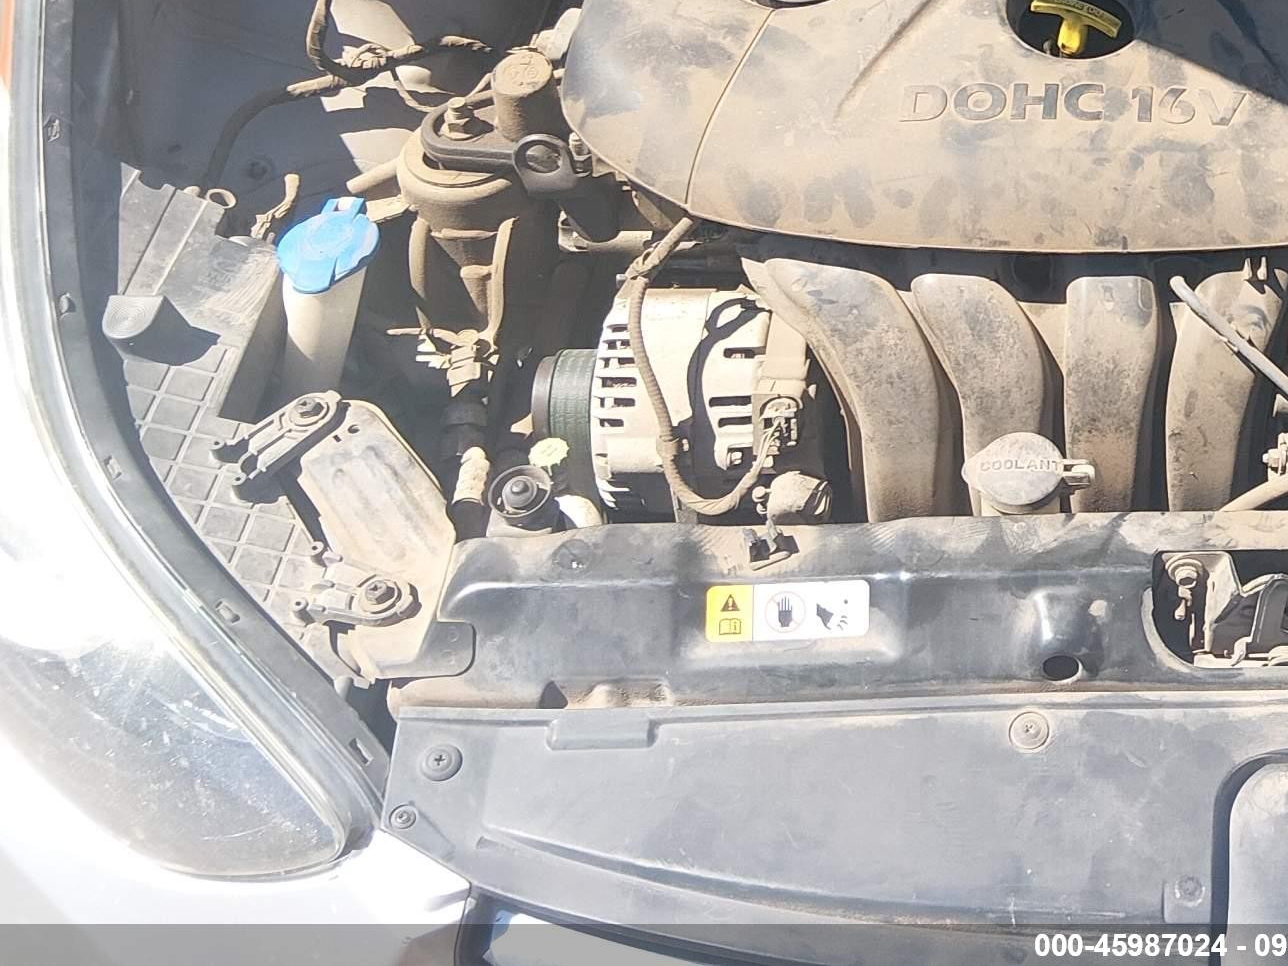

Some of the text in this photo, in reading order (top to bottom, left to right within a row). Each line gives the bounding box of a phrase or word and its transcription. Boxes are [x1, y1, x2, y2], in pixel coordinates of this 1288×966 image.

[898, 81, 1249, 127] DOHC 16V
[979, 458, 1060, 472] COOLANT
